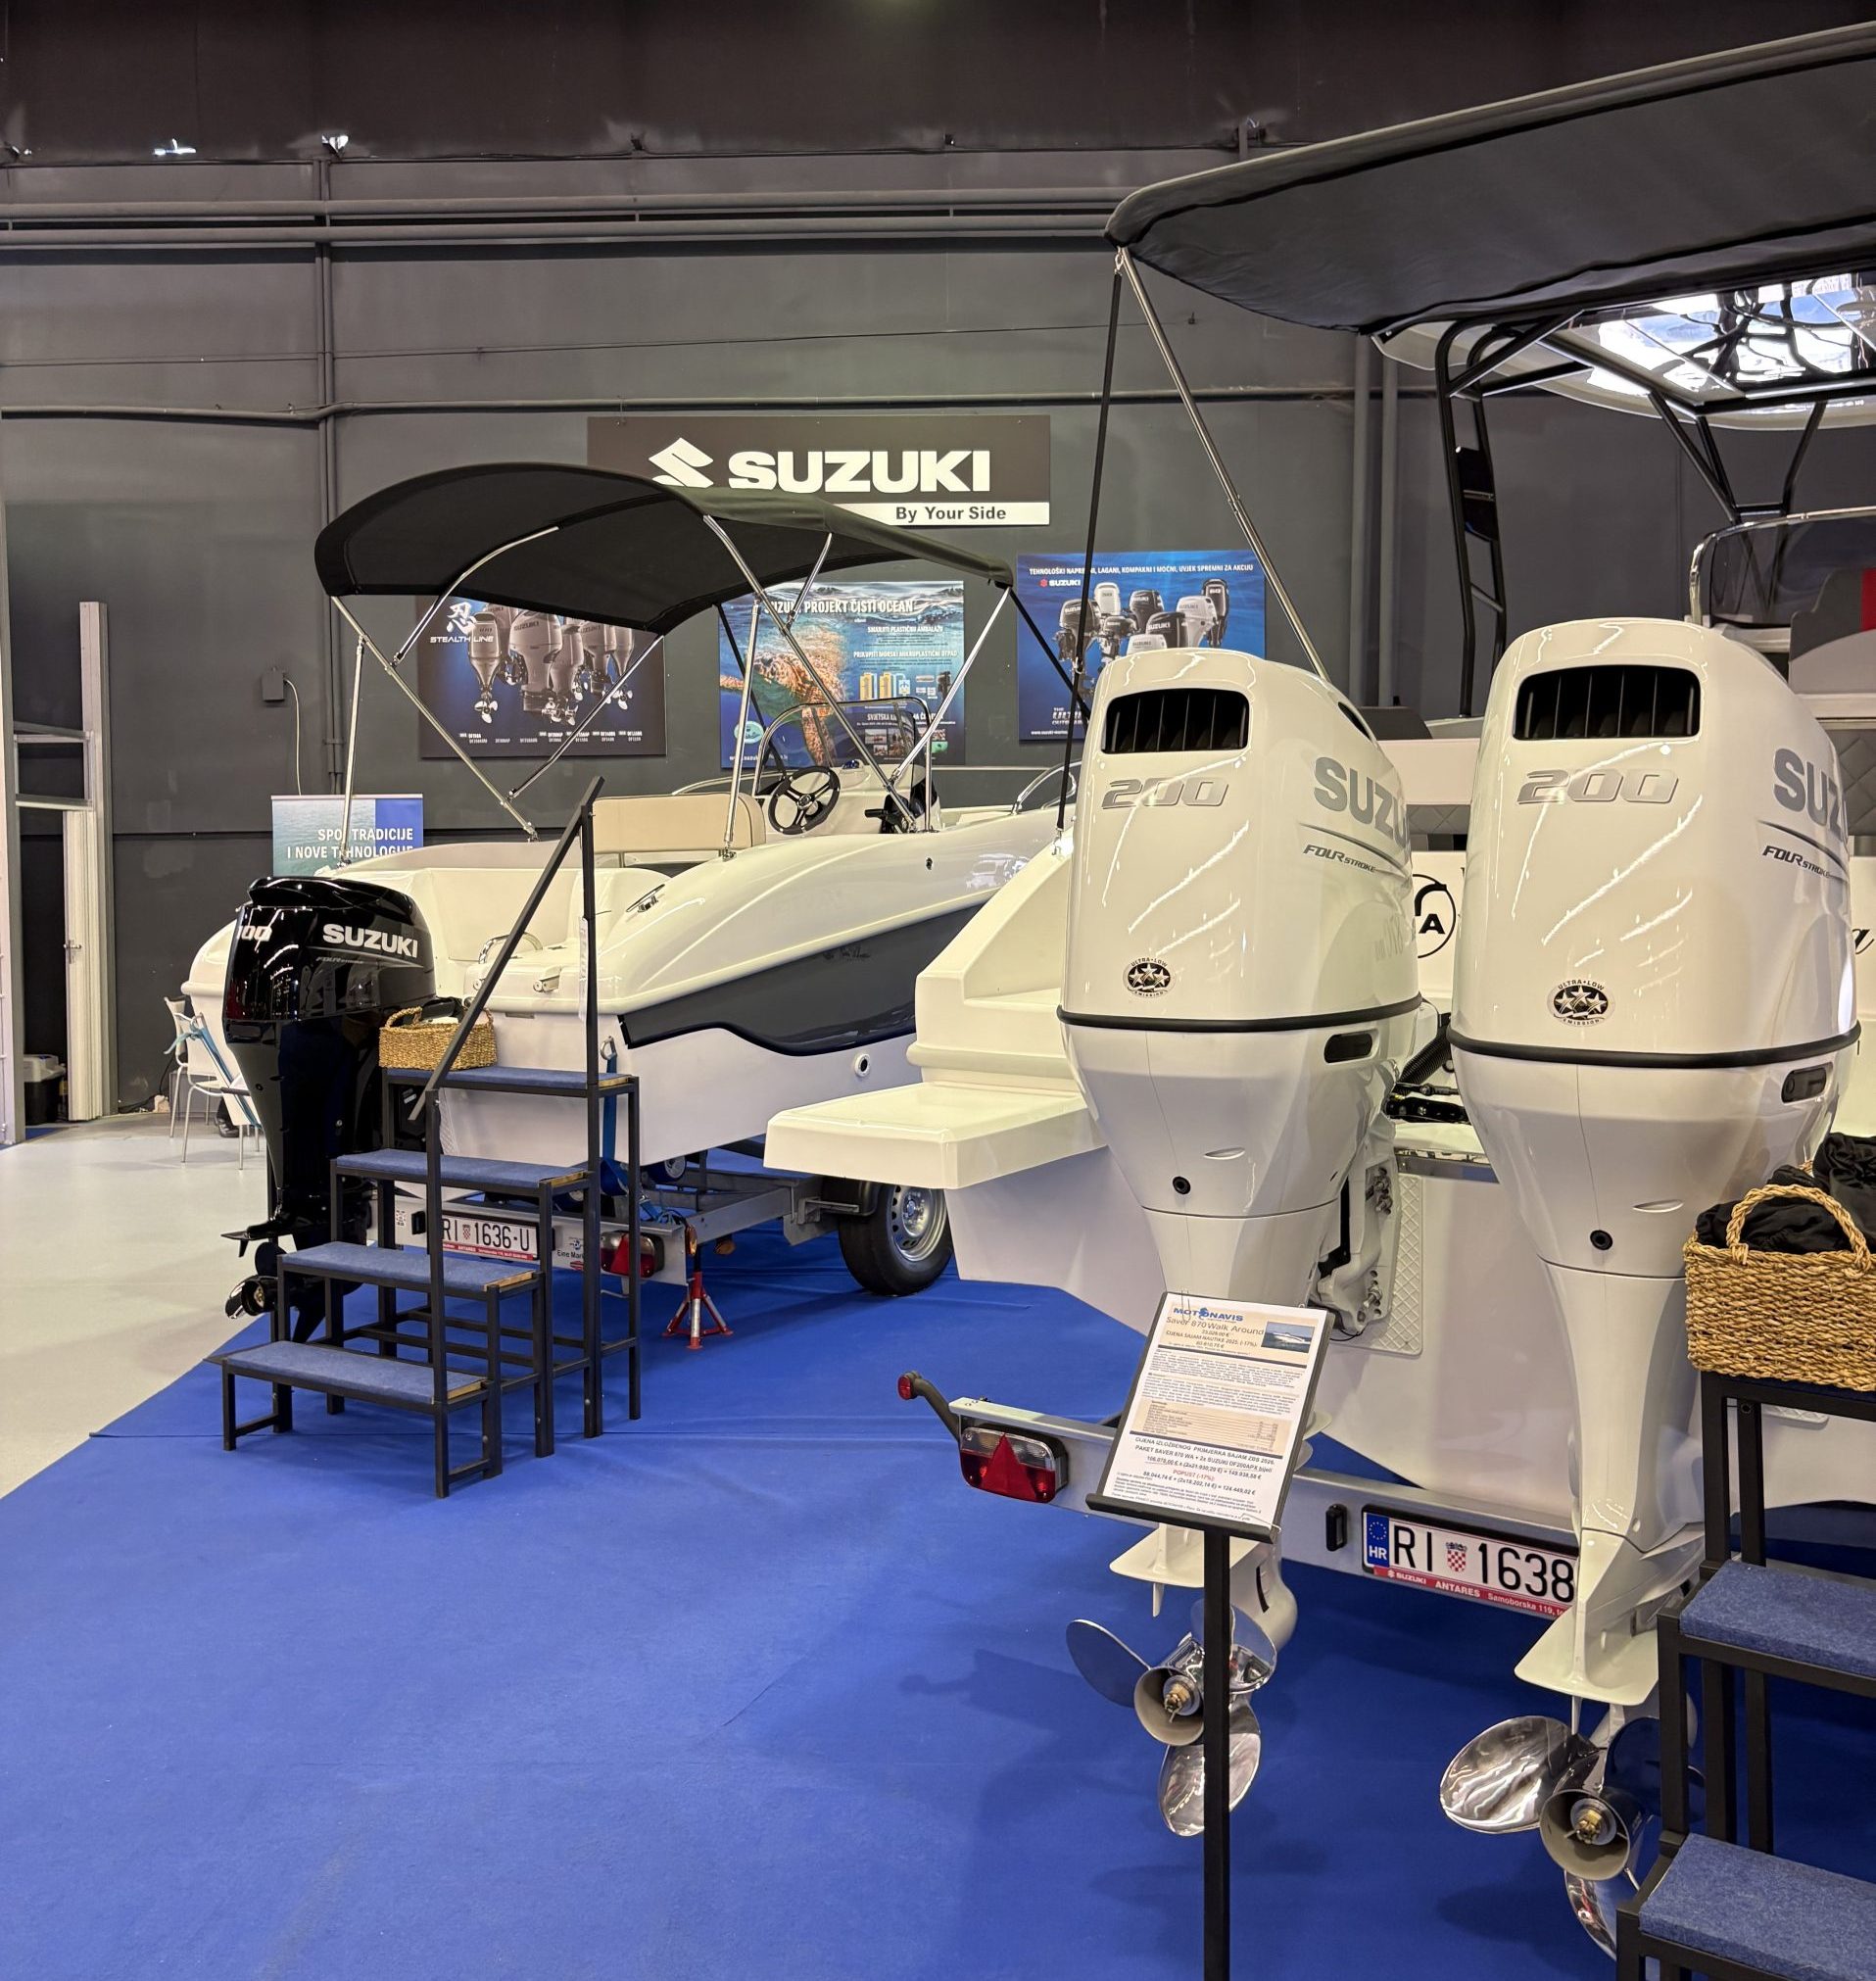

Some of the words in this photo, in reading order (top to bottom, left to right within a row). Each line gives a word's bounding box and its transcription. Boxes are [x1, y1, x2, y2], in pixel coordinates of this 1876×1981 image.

[728, 450, 990, 494] SUZUKI
[896, 506, 918, 523] By
[924, 506, 966, 520] Your
[968, 505, 1007, 520] Side
[804, 600, 848, 613] PROJEKT
[850, 598, 876, 613] ČISTI
[878, 600, 914, 613] OCEAN
[1101, 777, 1229, 810] 200
[1516, 768, 1679, 805] 200
[318, 828, 343, 841] SPO
[351, 828, 413, 841] TRADICIJE
[288, 846, 291, 859] I
[295, 846, 328, 859] NOVE
[322, 923, 418, 959] SUZUKI
[442, 1218, 458, 1242] RI
[475, 1222, 529, 1252] 1636-U
[1166, 1316, 1189, 1326] Saver
[1191, 1320, 1207, 1329] 870
[1207, 1323, 1228, 1331] Walk
[1230, 1326, 1264, 1335] Around
[1173, 1469, 1196, 1477] POPUST
[1208, 1457, 1228, 1465] SUZUKI
[1369, 1545, 1388, 1561] HR
[1394, 1524, 1433, 1572] RI
[1478, 1542, 1575, 1603] 1638
[1396, 1571, 1427, 1585] SUZUKI
[1435, 1580, 1481, 1598] ANTARES
[1488, 1593, 1537, 1611] Samoborska
[1539, 1604, 1555, 1616] 119,
